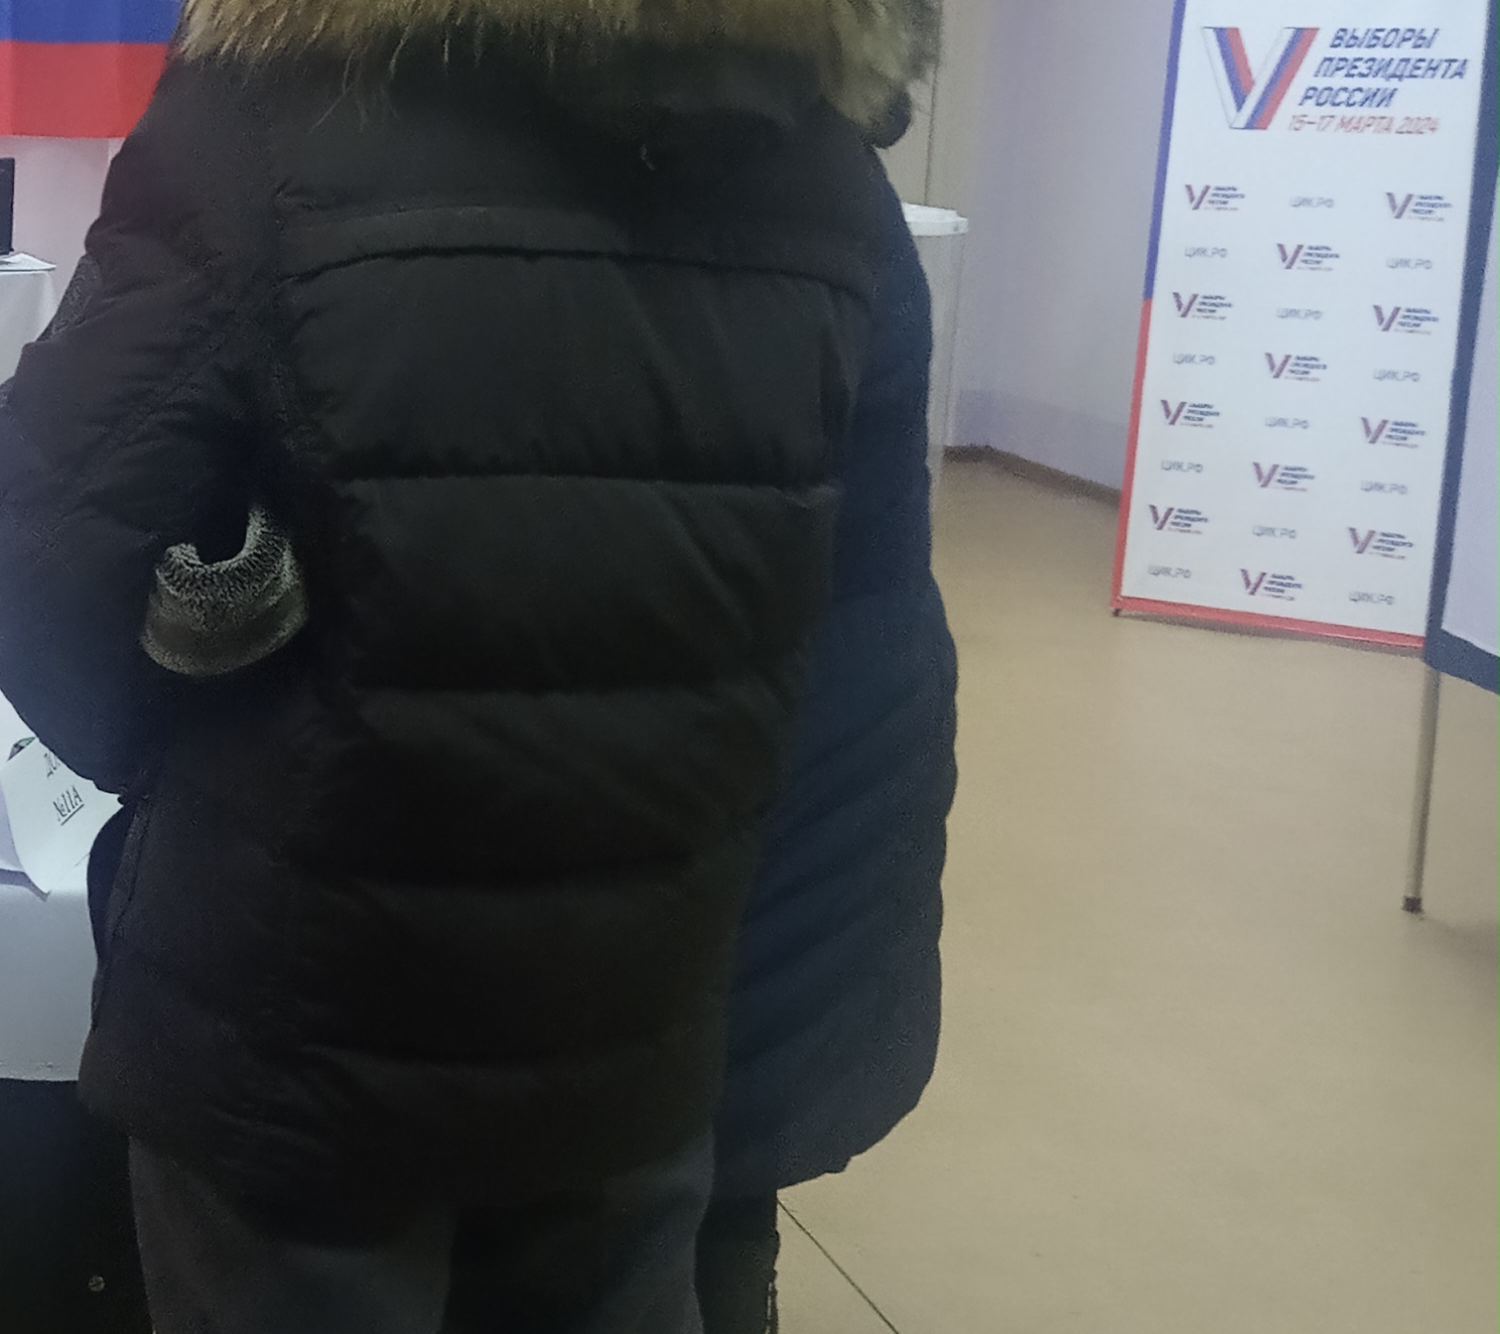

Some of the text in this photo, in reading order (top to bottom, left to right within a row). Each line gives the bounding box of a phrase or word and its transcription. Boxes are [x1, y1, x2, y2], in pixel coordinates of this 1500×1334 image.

[1328, 27, 1441, 49] ВЫБОРЫ
[1313, 56, 1469, 82] ПРЕЗИДЕНТА
[1297, 85, 1399, 108] РОССИИ
[1334, 115, 1394, 134] МАРТА
[1394, 116, 1441, 136] 2024
